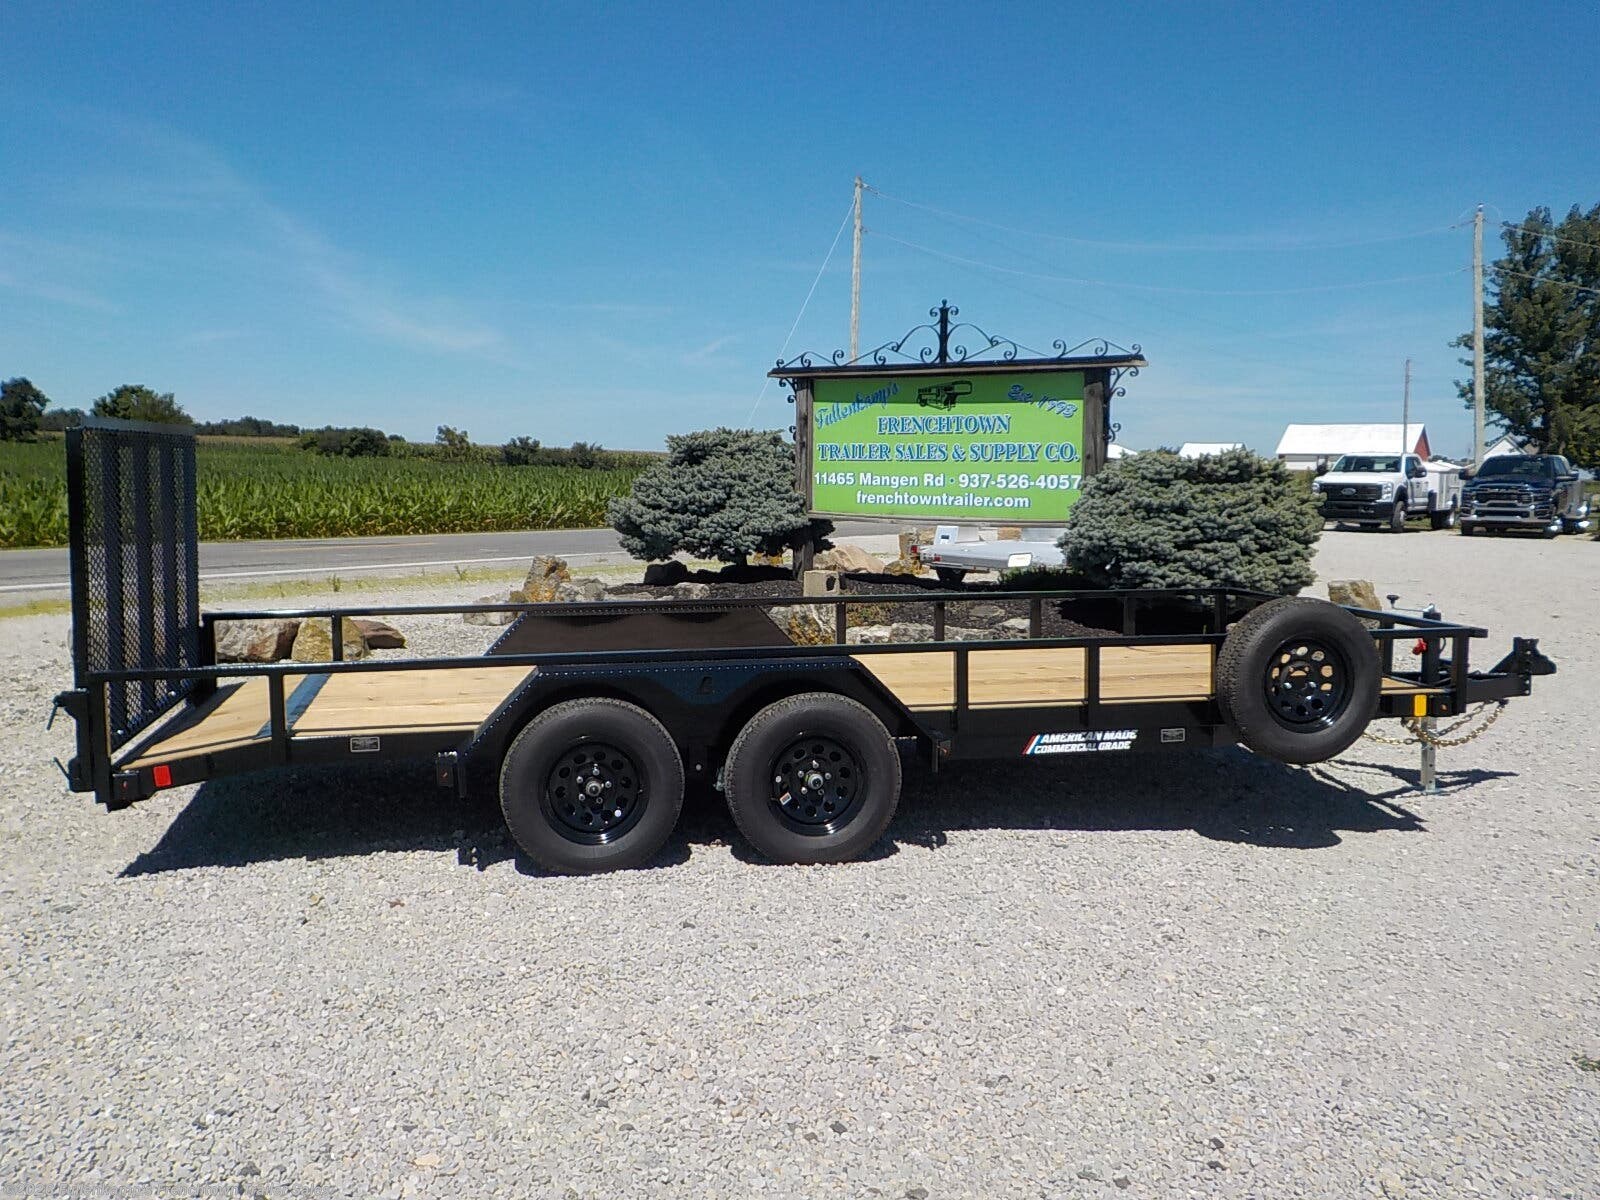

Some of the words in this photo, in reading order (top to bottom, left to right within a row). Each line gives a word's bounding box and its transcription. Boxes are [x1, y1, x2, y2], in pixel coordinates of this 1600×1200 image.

[877, 414, 1011, 435] FRENCHTOWN
[817, 442, 891, 462] TRAILER
[895, 442, 947, 462] SALES
[951, 443, 966, 462] &
[969, 442, 1043, 462] SUPPLY
[1045, 442, 1081, 463] CO.
[814, 471, 855, 486] 11465
[859, 472, 919, 490] Mangen
[923, 473, 945, 488] Rd
[958, 473, 1082, 490] 937-526-4057
[856, 491, 1031, 509] frenchtowntrailer.com
[1041, 732, 1102, 744] AMERICAN
[1103, 729, 1139, 741] MADE
[1034, 742, 1097, 754] COMMERCIAL
[1098, 741, 1132, 751] GRADE
